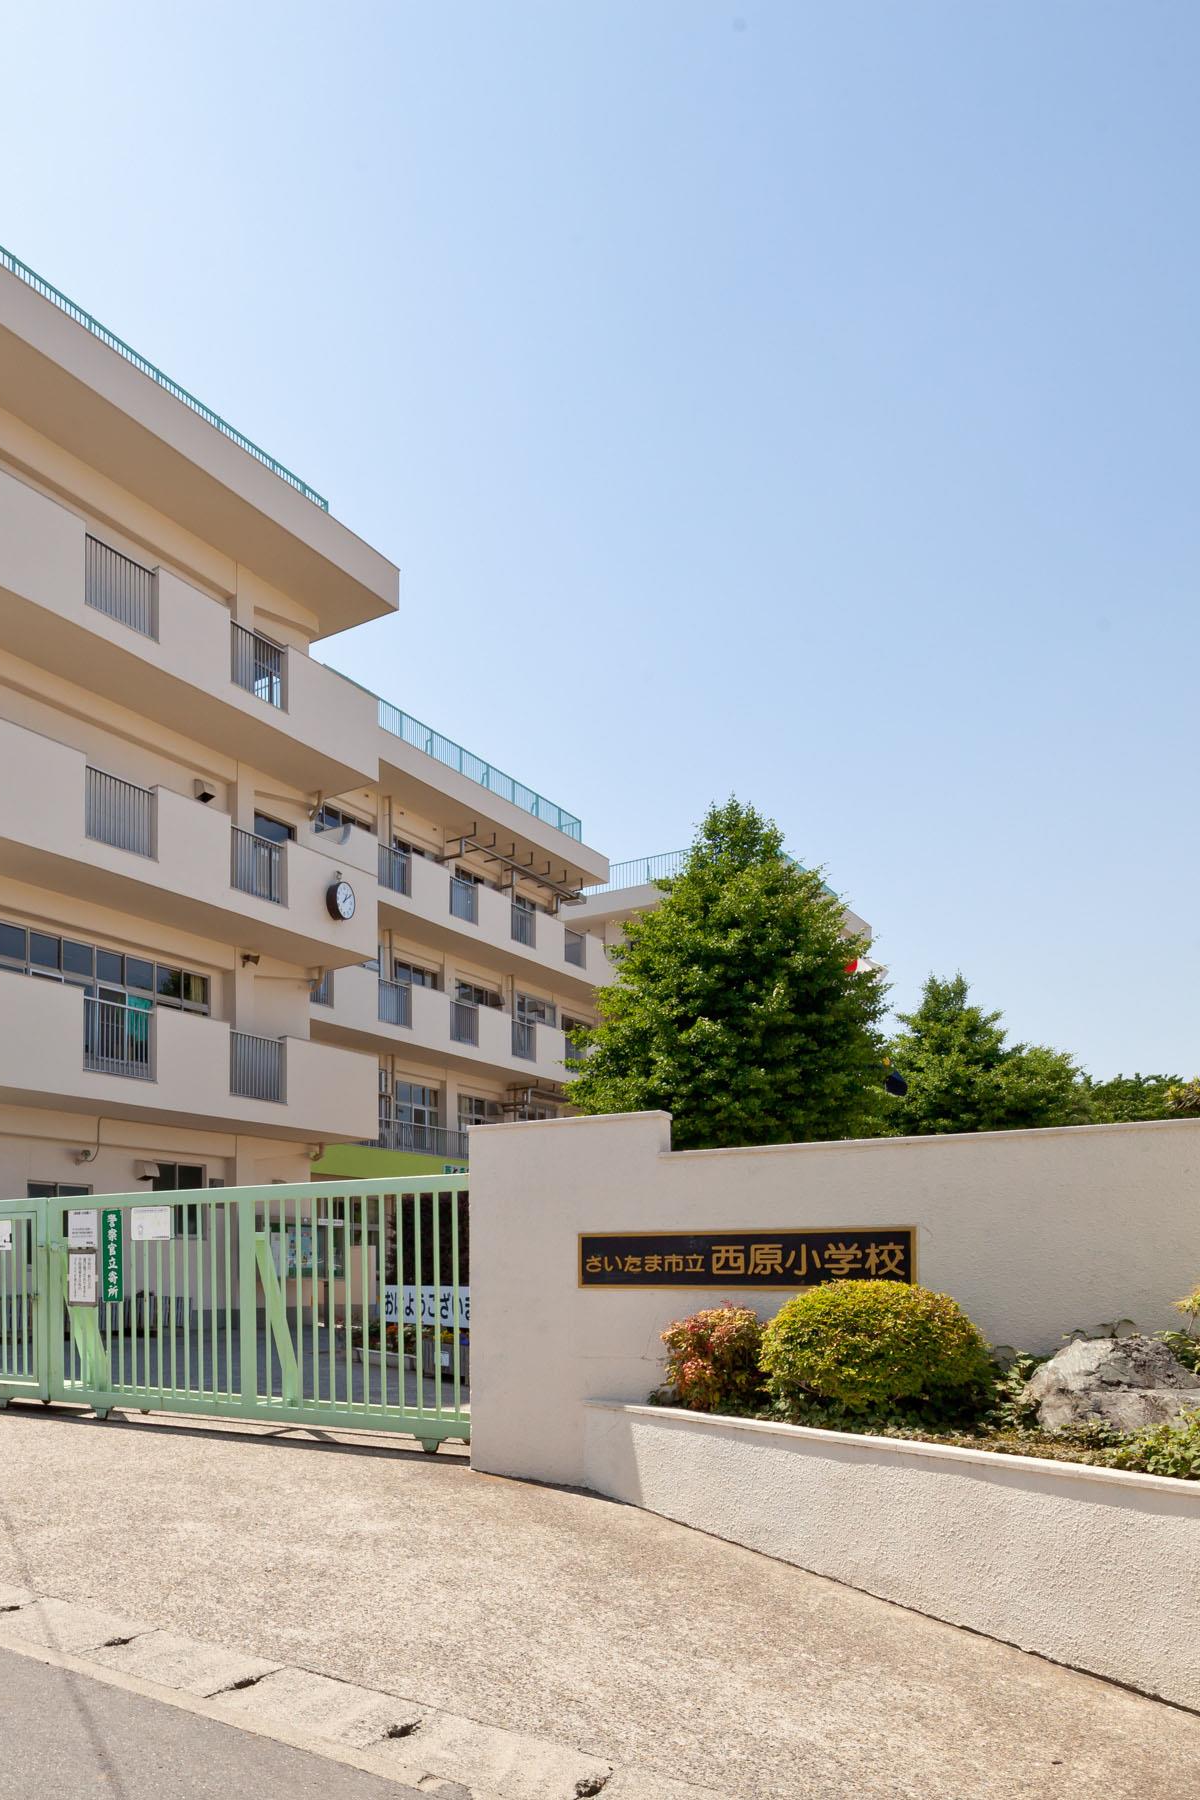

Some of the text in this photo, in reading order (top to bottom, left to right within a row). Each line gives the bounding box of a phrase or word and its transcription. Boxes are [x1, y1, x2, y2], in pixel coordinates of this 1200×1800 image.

[107, 1213, 119, 1299] 警察官立寄所
[585, 1241, 906, 1277] さいたま市立 西原小学校
